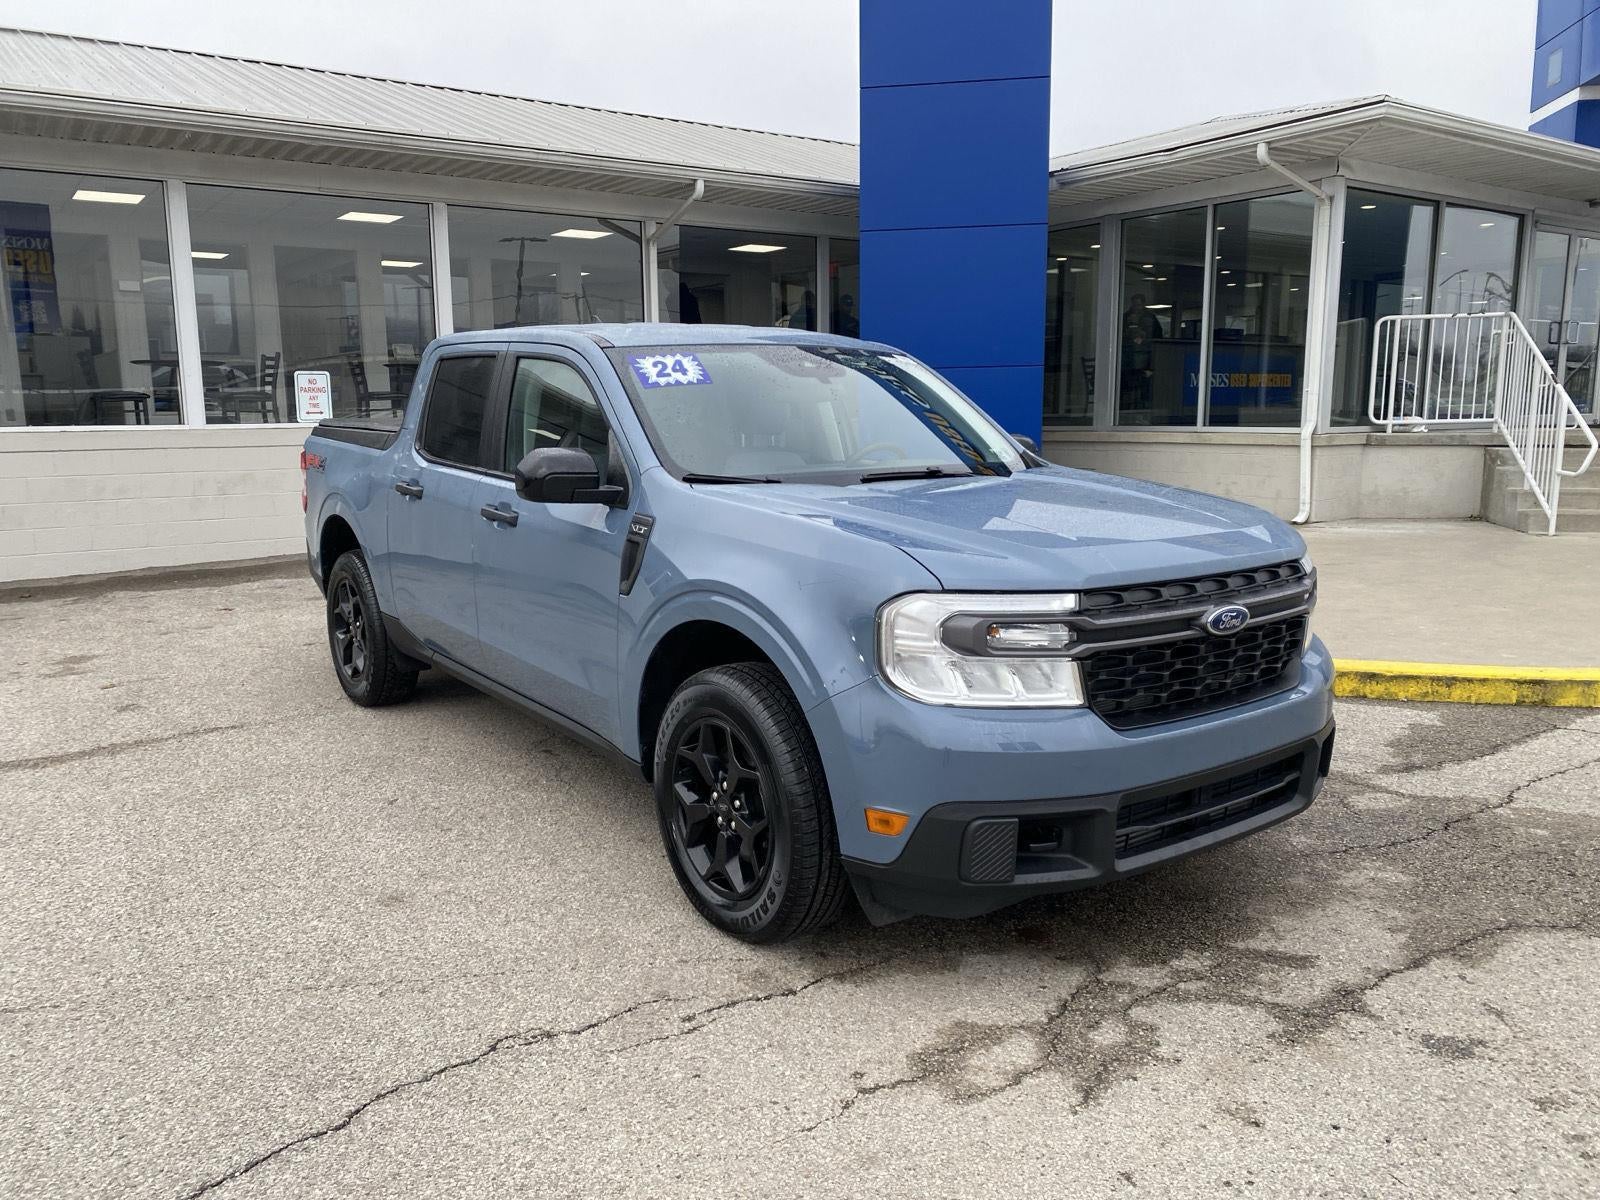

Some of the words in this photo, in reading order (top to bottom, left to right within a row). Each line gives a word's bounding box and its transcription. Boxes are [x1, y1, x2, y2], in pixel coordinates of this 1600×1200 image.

[652, 359, 689, 378] 24
[1190, 373, 1230, 388] MSES
[299, 386, 327, 394] PARKING
[631, 523, 649, 534] XLT
[1219, 612, 1242, 629] Ford
